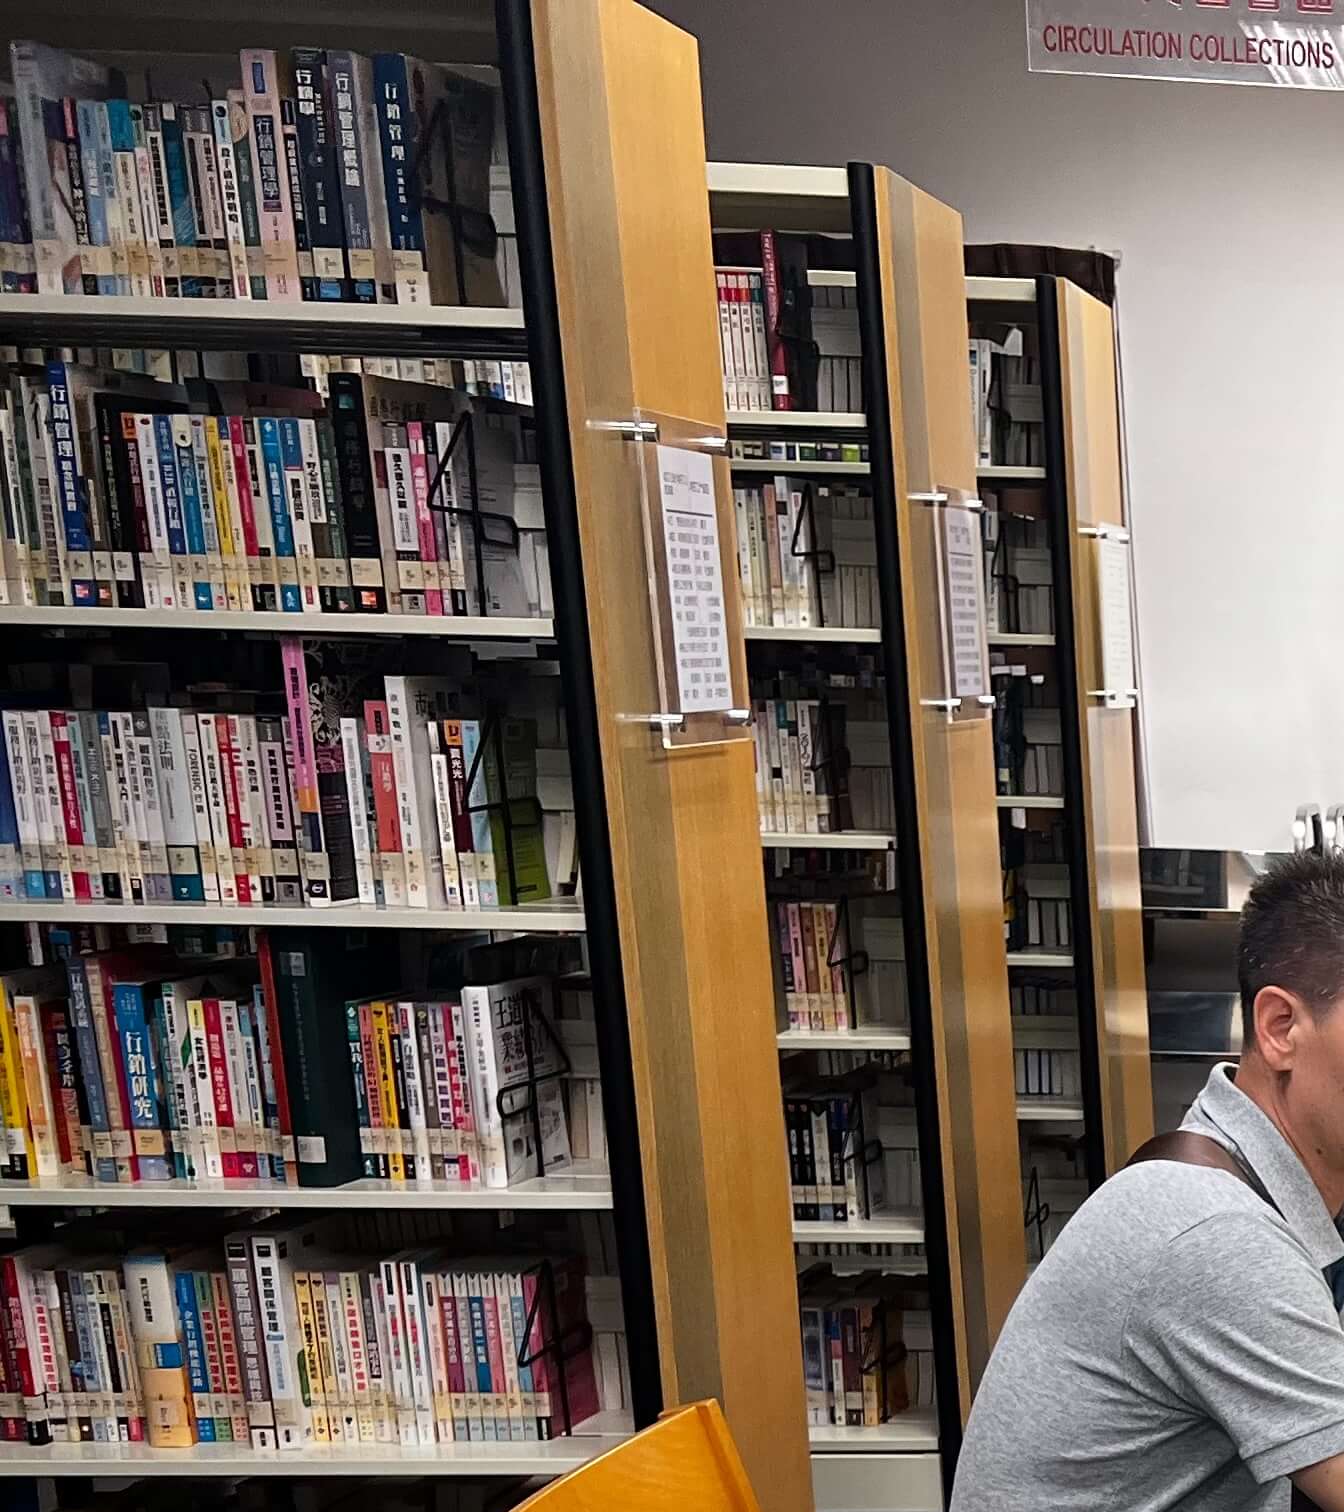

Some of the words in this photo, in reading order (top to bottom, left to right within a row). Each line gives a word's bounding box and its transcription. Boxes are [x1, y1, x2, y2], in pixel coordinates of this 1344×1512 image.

[1043, 24, 1183, 60] CIRCULATION
[1190, 33, 1335, 69] COLLECTIONS
[49, 384, 74, 458] 行銷管理
